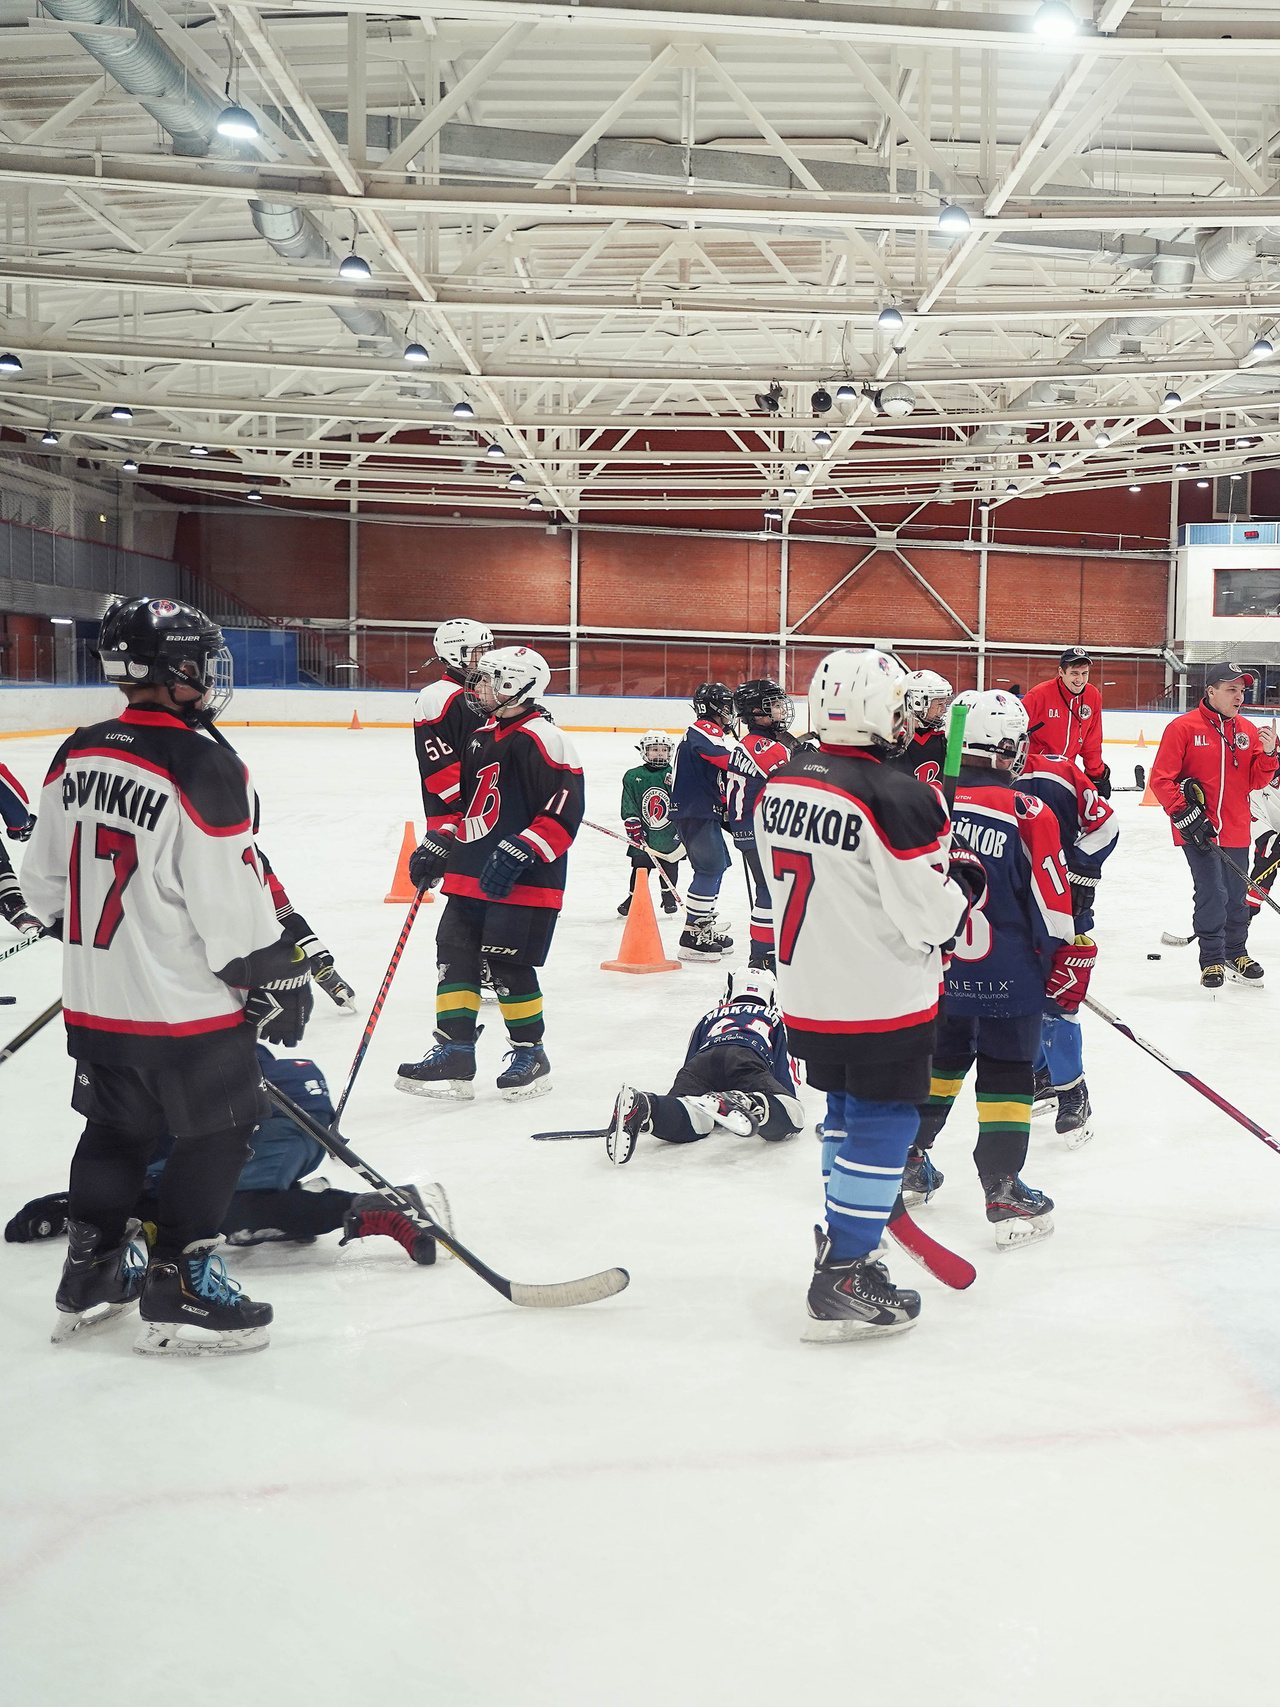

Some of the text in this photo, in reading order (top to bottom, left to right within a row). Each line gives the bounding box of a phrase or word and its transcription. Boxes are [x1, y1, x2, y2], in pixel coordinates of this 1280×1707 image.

[834, 682, 842, 697] 7
[697, 703, 708, 714] 19
[105, 732, 135, 744] LUTCH
[803, 763, 829, 775] LUTCH
[69, 820, 140, 951] 17
[771, 847, 816, 966] 7
[480, 945, 519, 956] CCM
[351, 1162, 434, 1229] CCM
